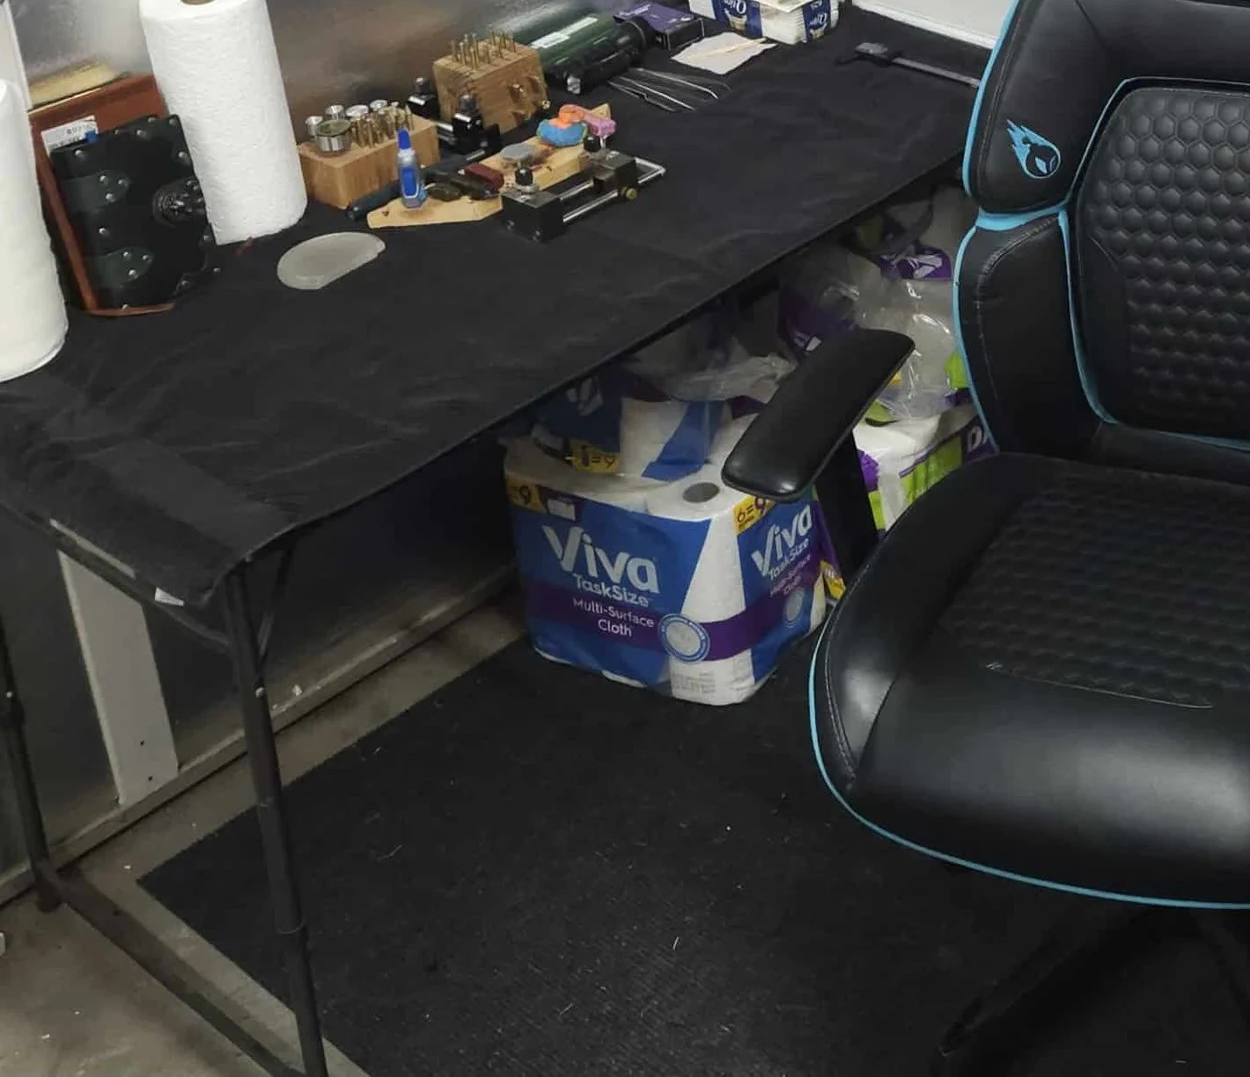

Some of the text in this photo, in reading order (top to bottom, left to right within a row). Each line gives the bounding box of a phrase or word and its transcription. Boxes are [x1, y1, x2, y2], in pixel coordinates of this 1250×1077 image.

[751, 503, 813, 577] Viva
[541, 524, 660, 594] Viva
[571, 573, 650, 607] TaskSize
[572, 598, 655, 628] Multi-Surface
[597, 618, 632, 637] Cloth
